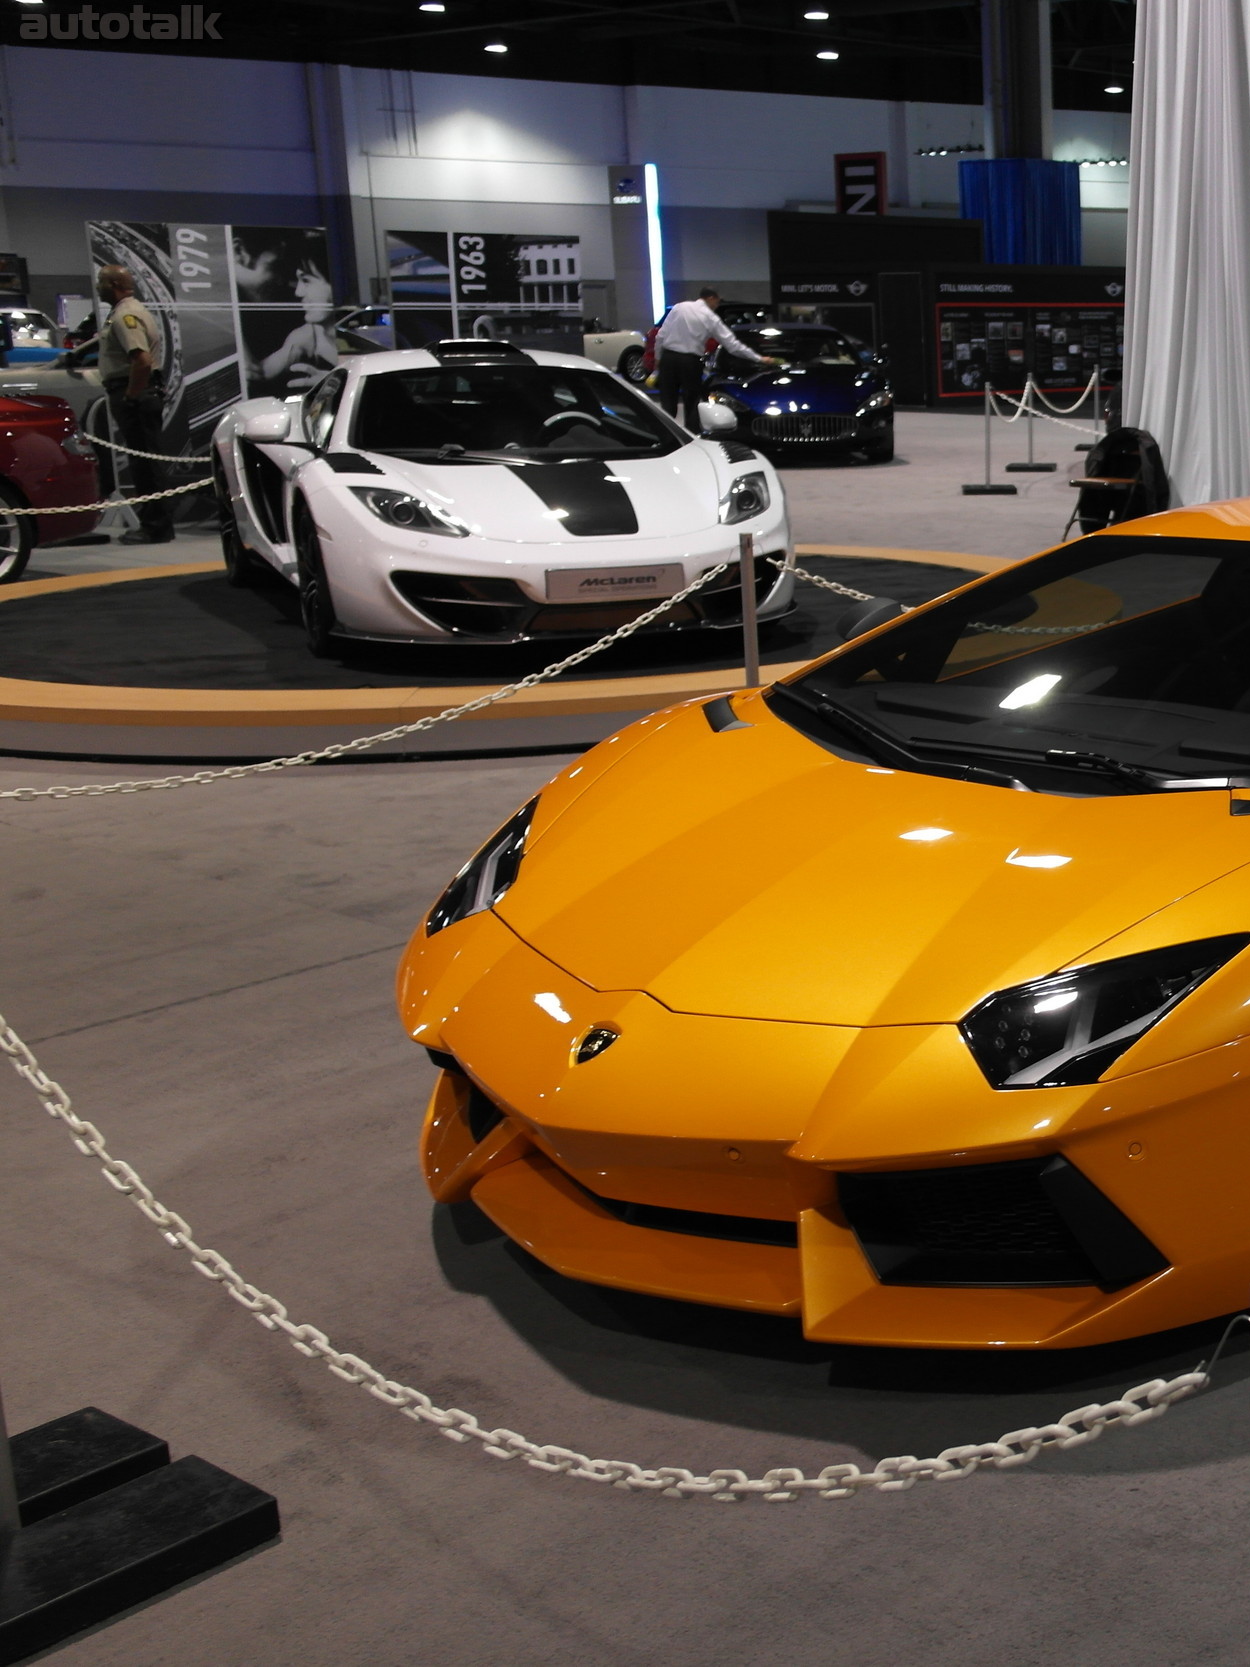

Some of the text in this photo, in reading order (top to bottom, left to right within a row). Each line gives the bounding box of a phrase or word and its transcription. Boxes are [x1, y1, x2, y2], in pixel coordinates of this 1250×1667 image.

[176, 228, 211, 292] 1979
[458, 236, 486, 294] 1963
[579, 575, 656, 586] McLaren
